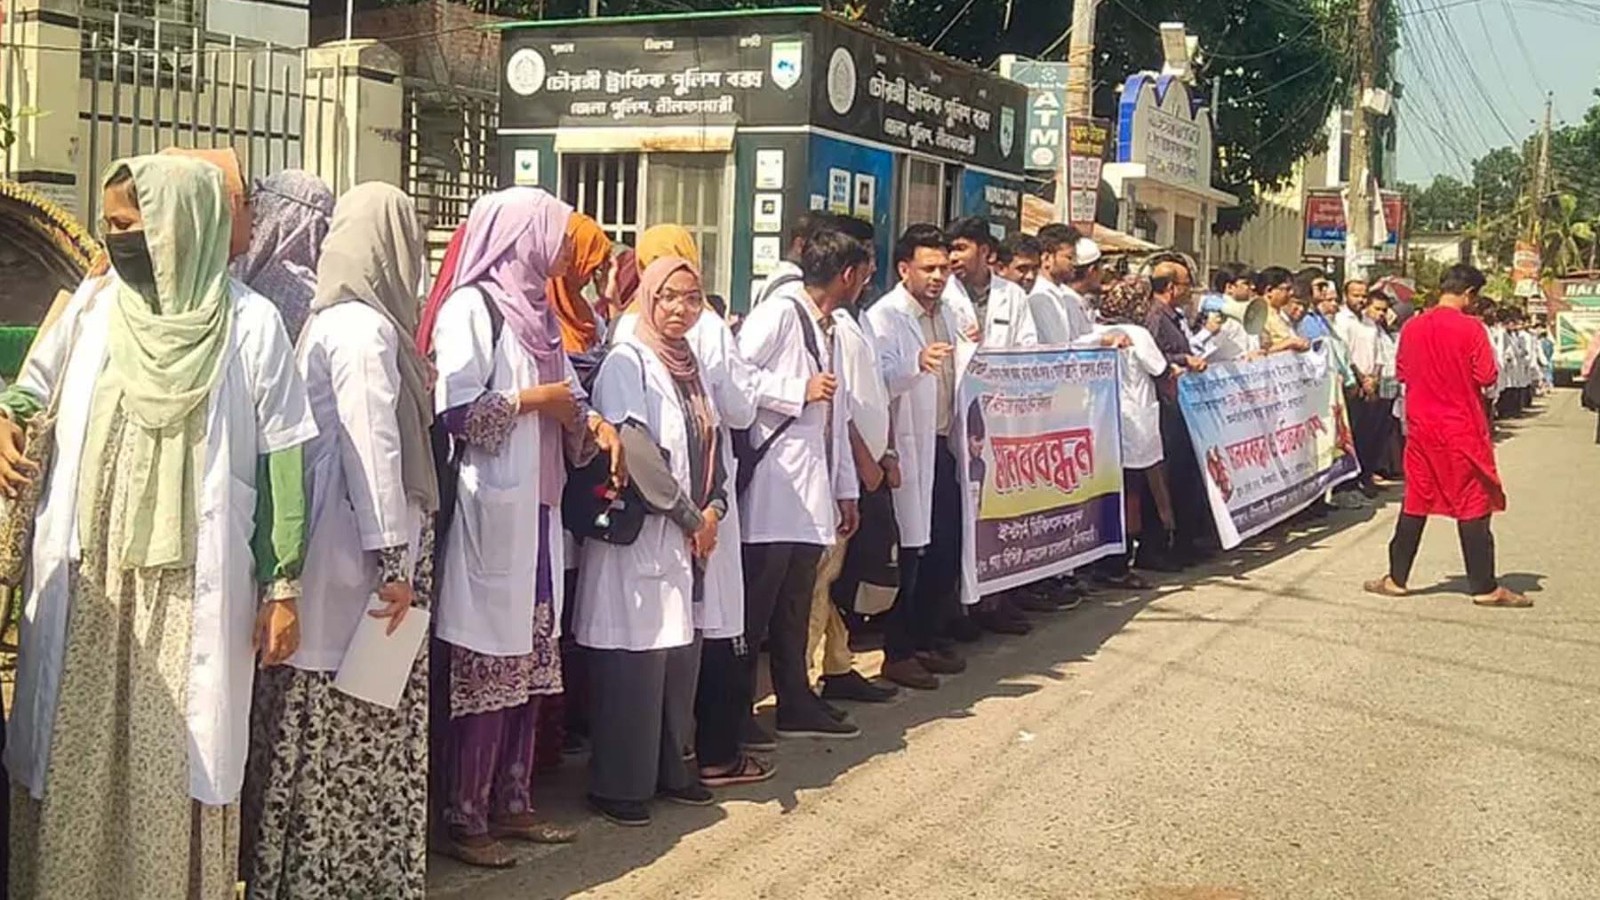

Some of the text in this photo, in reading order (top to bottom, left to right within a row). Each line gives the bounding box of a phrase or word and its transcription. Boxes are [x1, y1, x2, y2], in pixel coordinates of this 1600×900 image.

[606, 68, 666, 94] ট্রাফিক
[671, 66, 722, 96] পুলিশ
[725, 70, 764, 88] বক্স
[990, 427, 1094, 494] মানববন্ধন
